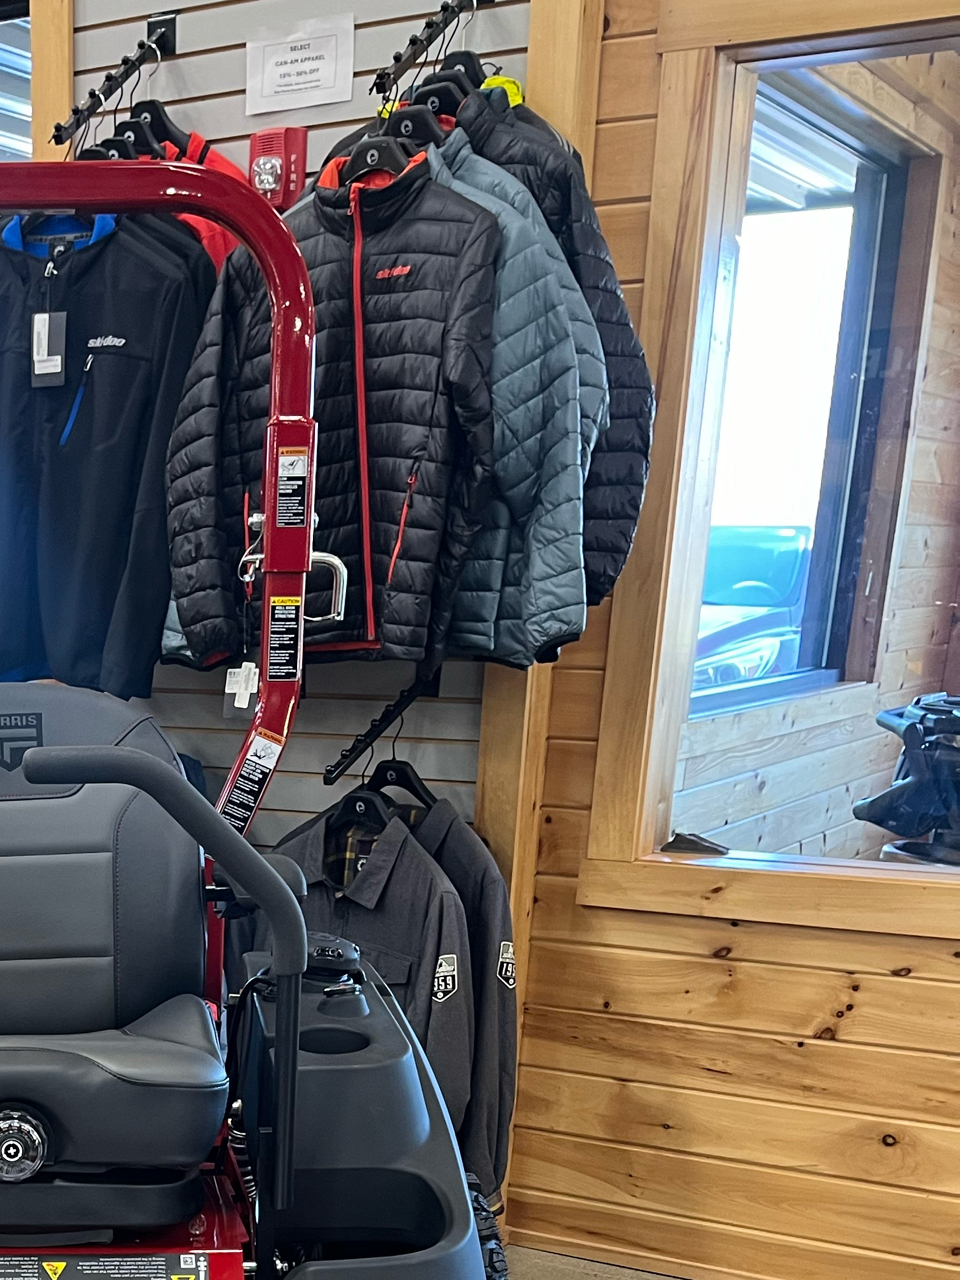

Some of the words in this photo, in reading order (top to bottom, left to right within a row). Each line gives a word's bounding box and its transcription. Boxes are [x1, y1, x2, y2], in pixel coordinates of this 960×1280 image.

[289, 43, 311, 52] SELECT
[275, 58, 299, 67] CAN-AM
[300, 54, 326, 64] APPAREL
[309, 67, 320, 75] OFF
[87, 335, 126, 349] ski-doo
